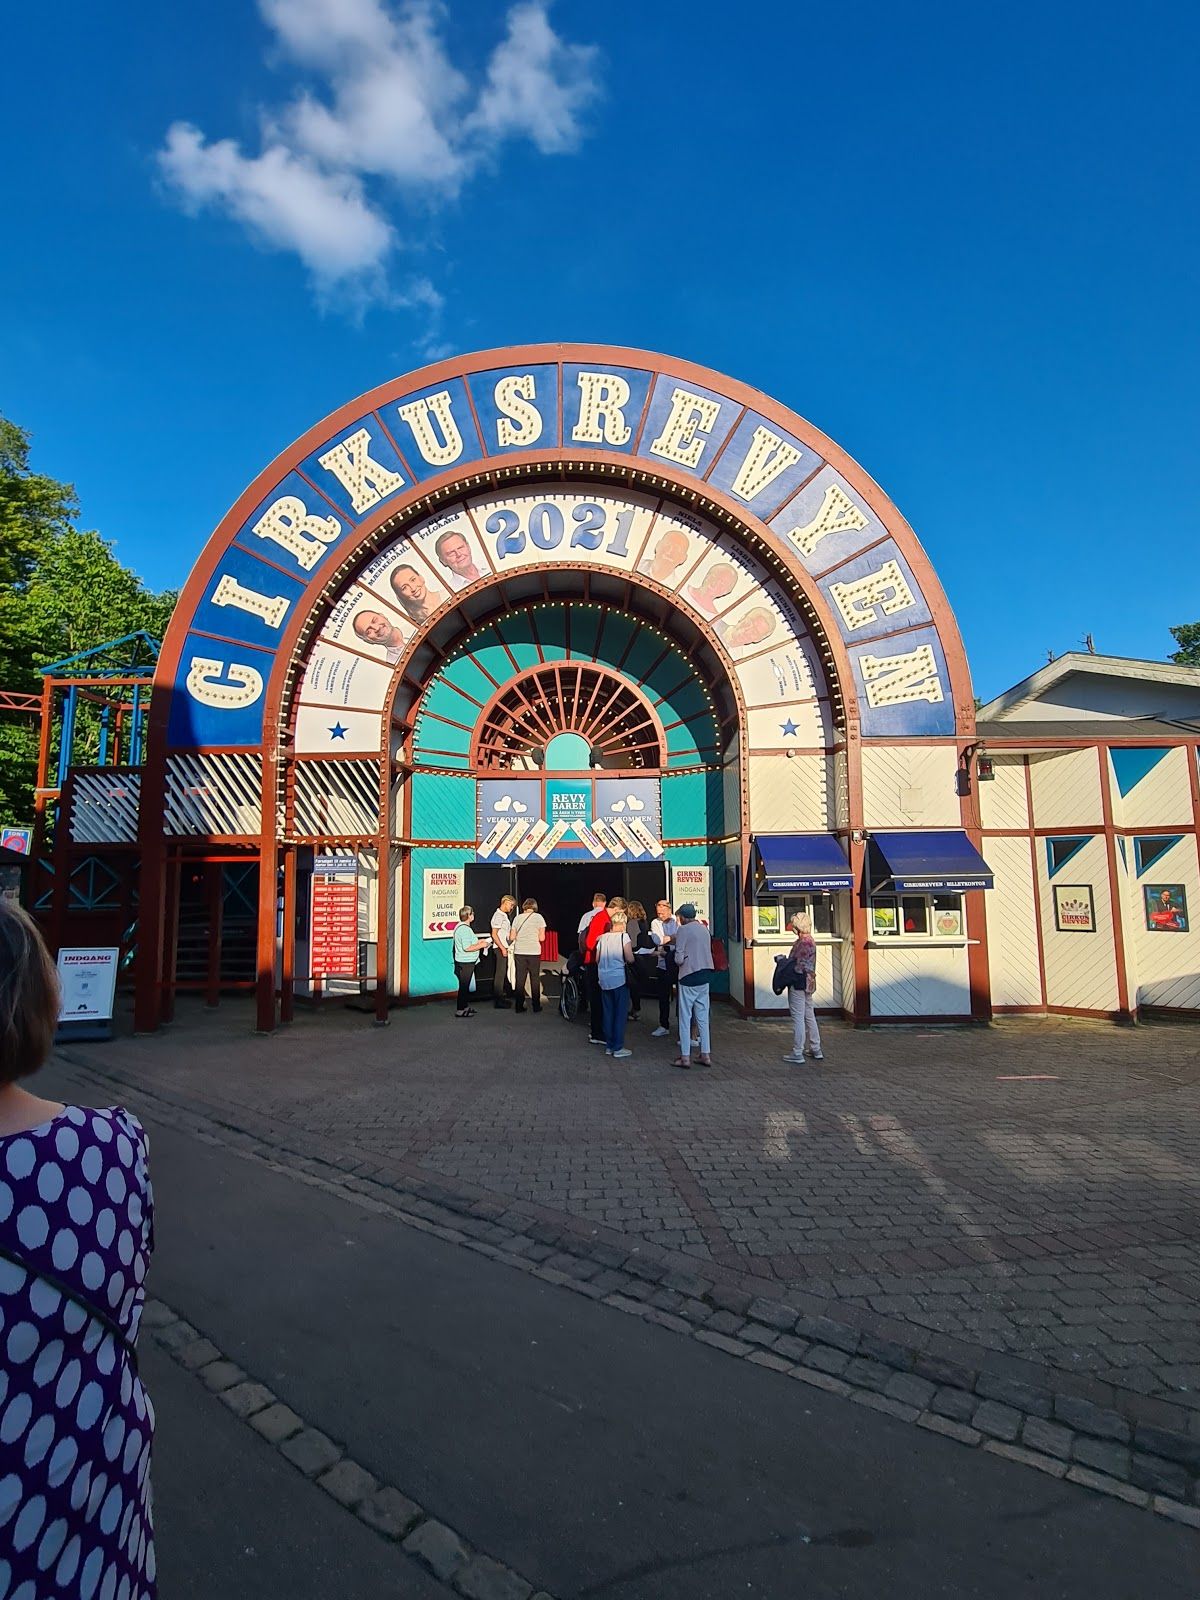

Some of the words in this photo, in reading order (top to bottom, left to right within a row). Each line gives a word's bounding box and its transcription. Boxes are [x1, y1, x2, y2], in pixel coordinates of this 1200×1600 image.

[186, 371, 944, 710] CIRKUSREVYEN
[420, 514, 460, 540] PILGAARD
[485, 502, 636, 560] 2021
[368, 546, 411, 587] MÆRKEDAHL
[332, 598, 349, 623] NIELS
[332, 591, 364, 639] ELLEGAARD
[552, 793, 586, 802] REVY
[552, 802, 586, 810] BAREN
